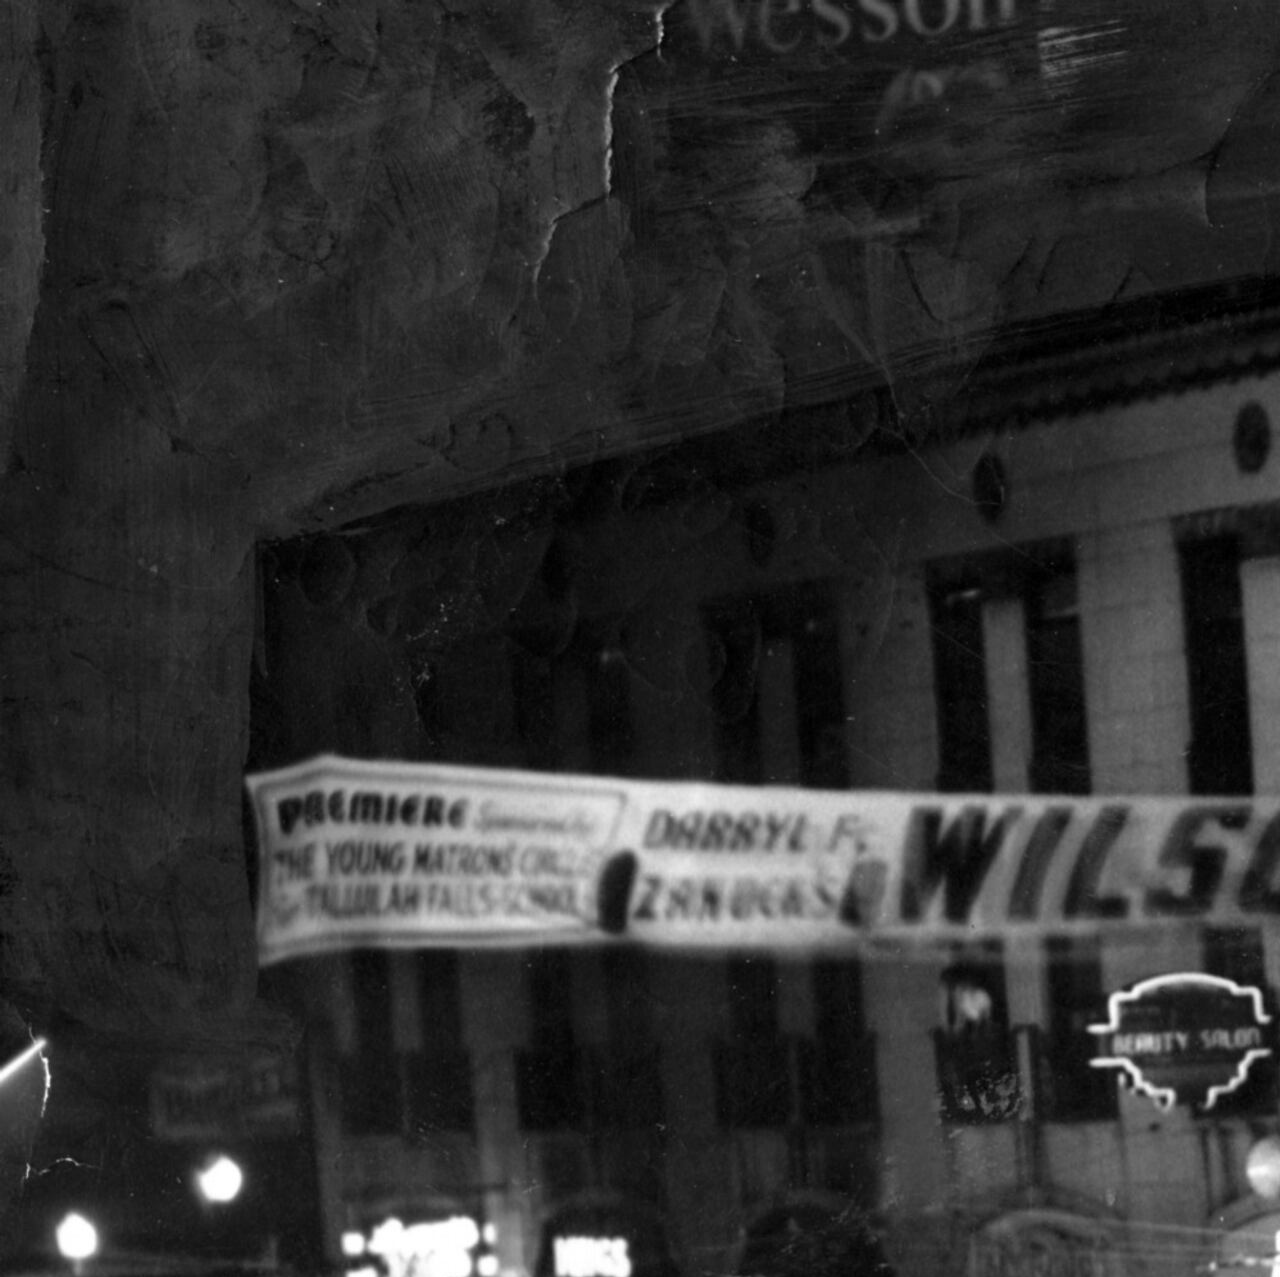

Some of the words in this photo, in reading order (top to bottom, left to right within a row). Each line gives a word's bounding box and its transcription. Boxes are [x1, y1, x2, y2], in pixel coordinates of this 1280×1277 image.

[642, 807, 808, 854] DARRYL
[326, 840, 407, 877] YOUNG
[1112, 1031, 1189, 1055] BEAUTY
